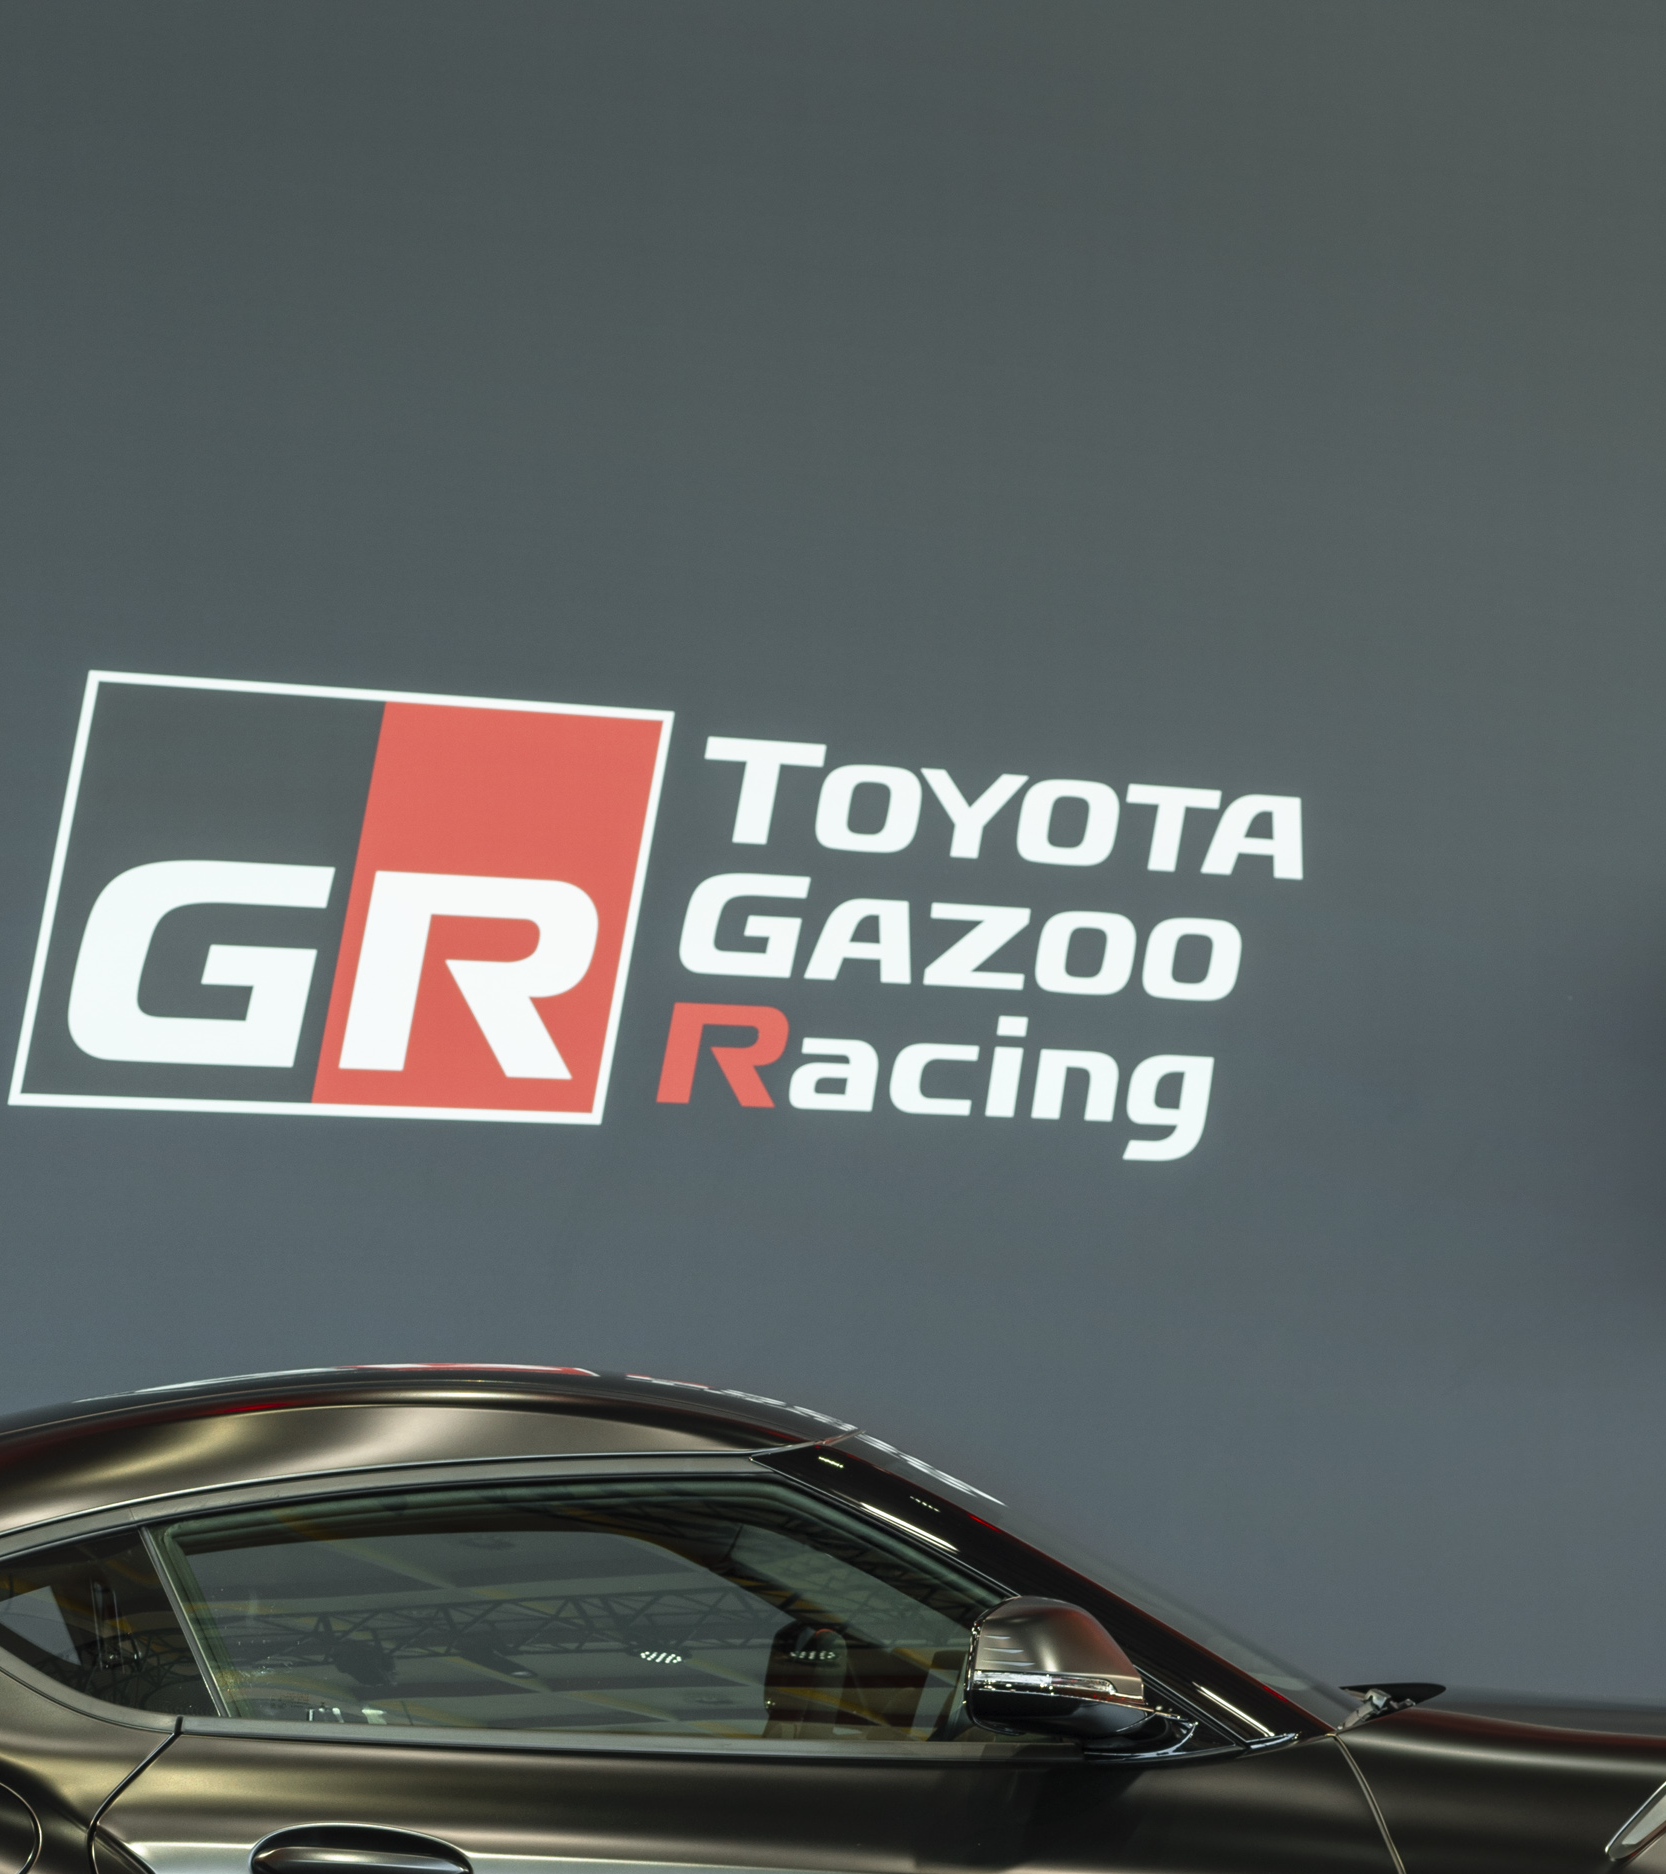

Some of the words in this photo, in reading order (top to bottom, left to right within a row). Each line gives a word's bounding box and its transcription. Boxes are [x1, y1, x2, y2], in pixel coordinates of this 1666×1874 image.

[705, 737, 1302, 879] TOYOTA
[69, 861, 598, 1079] GR
[680, 874, 1241, 1000] GAZOO
[657, 1003, 1213, 1160] Racing
